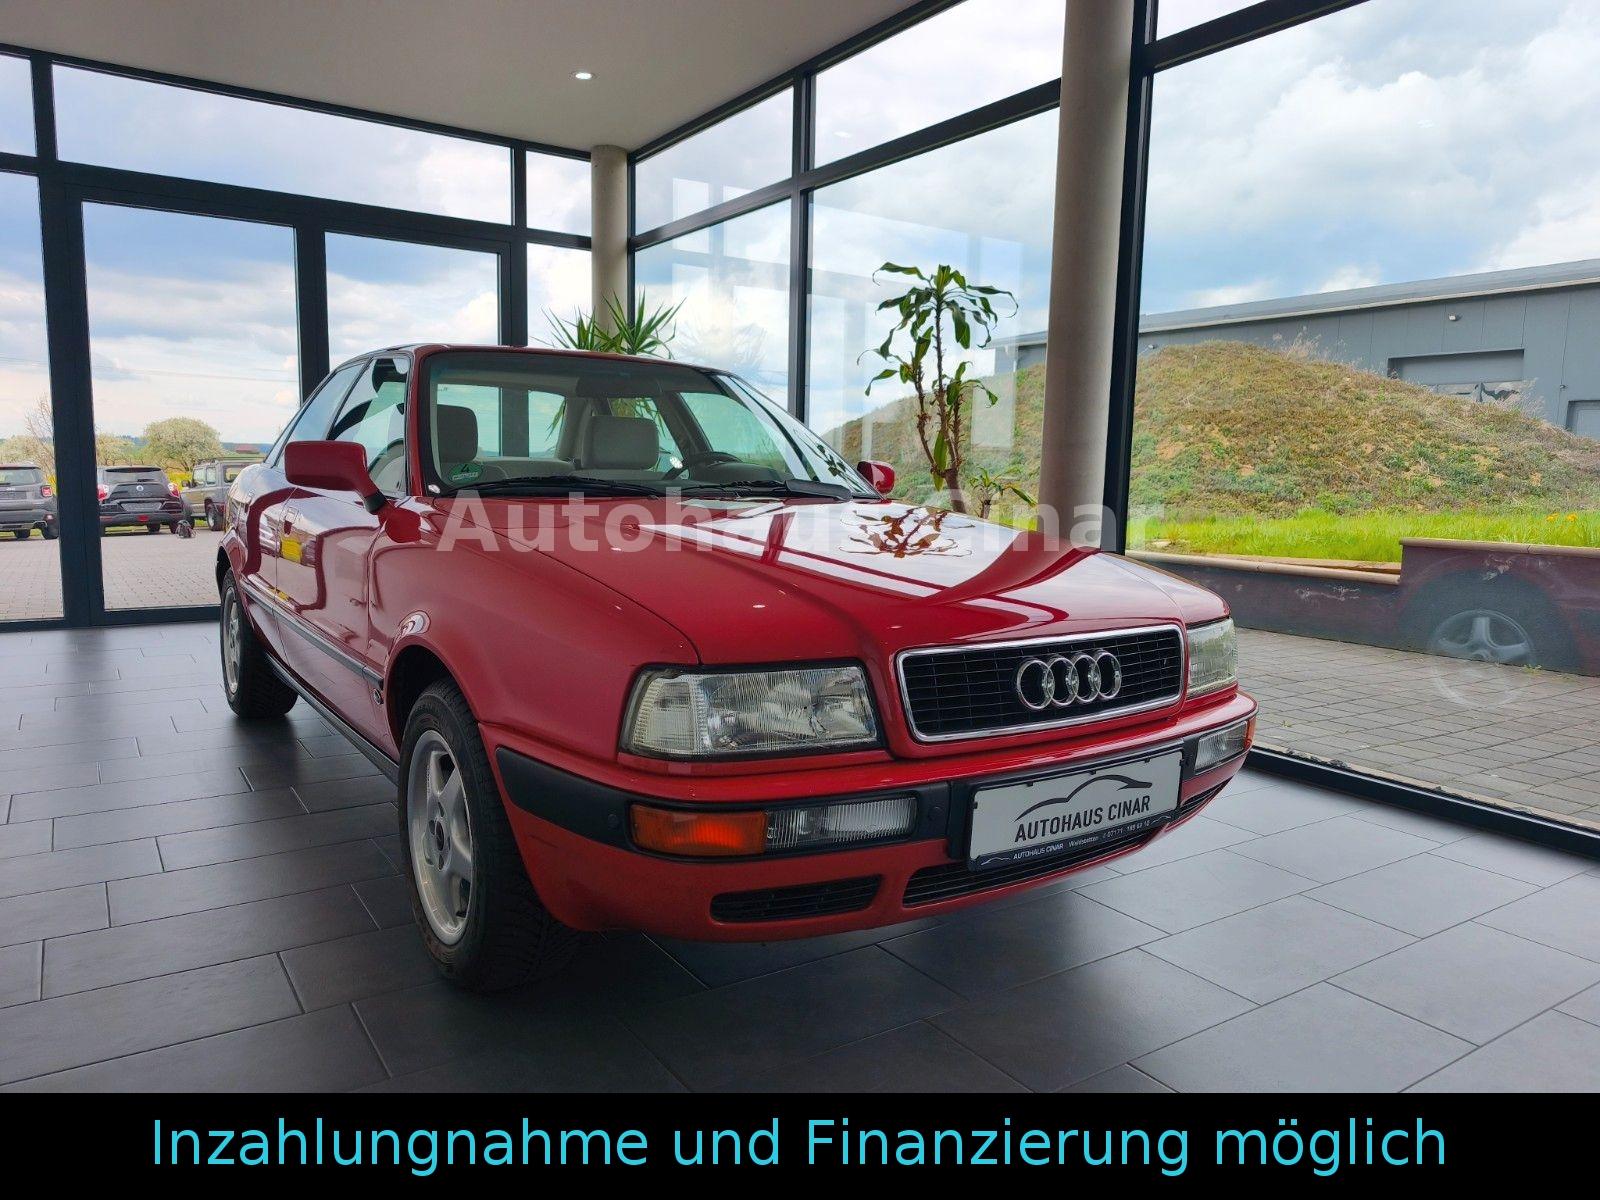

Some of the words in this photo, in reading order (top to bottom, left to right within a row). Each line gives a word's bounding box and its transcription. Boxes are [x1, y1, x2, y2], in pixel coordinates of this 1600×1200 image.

[1014, 806, 1103, 843] AUTOHAUS
[1107, 795, 1151, 821] CINAR
[1012, 847, 1046, 860] AUTOHAUS
[1046, 843, 1065, 854] CINAR
